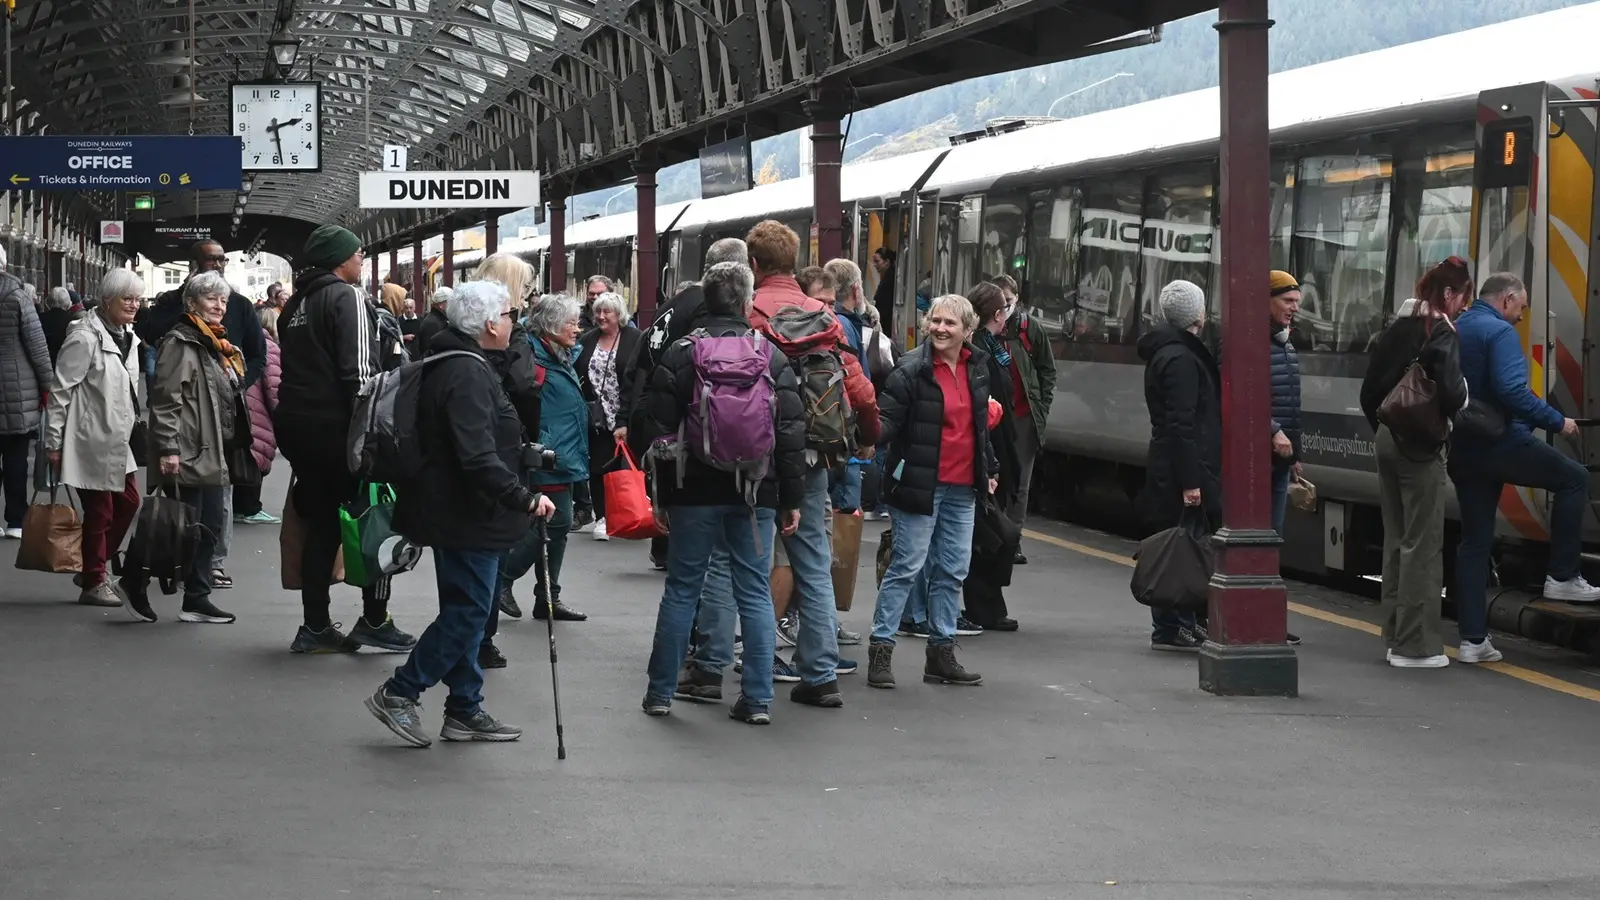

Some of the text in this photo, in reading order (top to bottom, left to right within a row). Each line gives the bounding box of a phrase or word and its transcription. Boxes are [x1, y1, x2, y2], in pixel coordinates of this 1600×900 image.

[252, 89, 260, 99] 11
[270, 89, 280, 99] 12
[237, 103, 247, 113] 10
[305, 103, 312, 113] 2
[239, 122, 246, 132] 9
[305, 122, 312, 132] 3
[305, 141, 312, 151] 4
[68, 155, 133, 169] OFFICE
[253, 155, 260, 164] 7
[272, 155, 279, 164] 6
[291, 155, 298, 164] 5
[390, 149, 400, 168] 1
[39, 174, 151, 184] Tickets & Information
[389, 179, 510, 200] DUNEDIN
